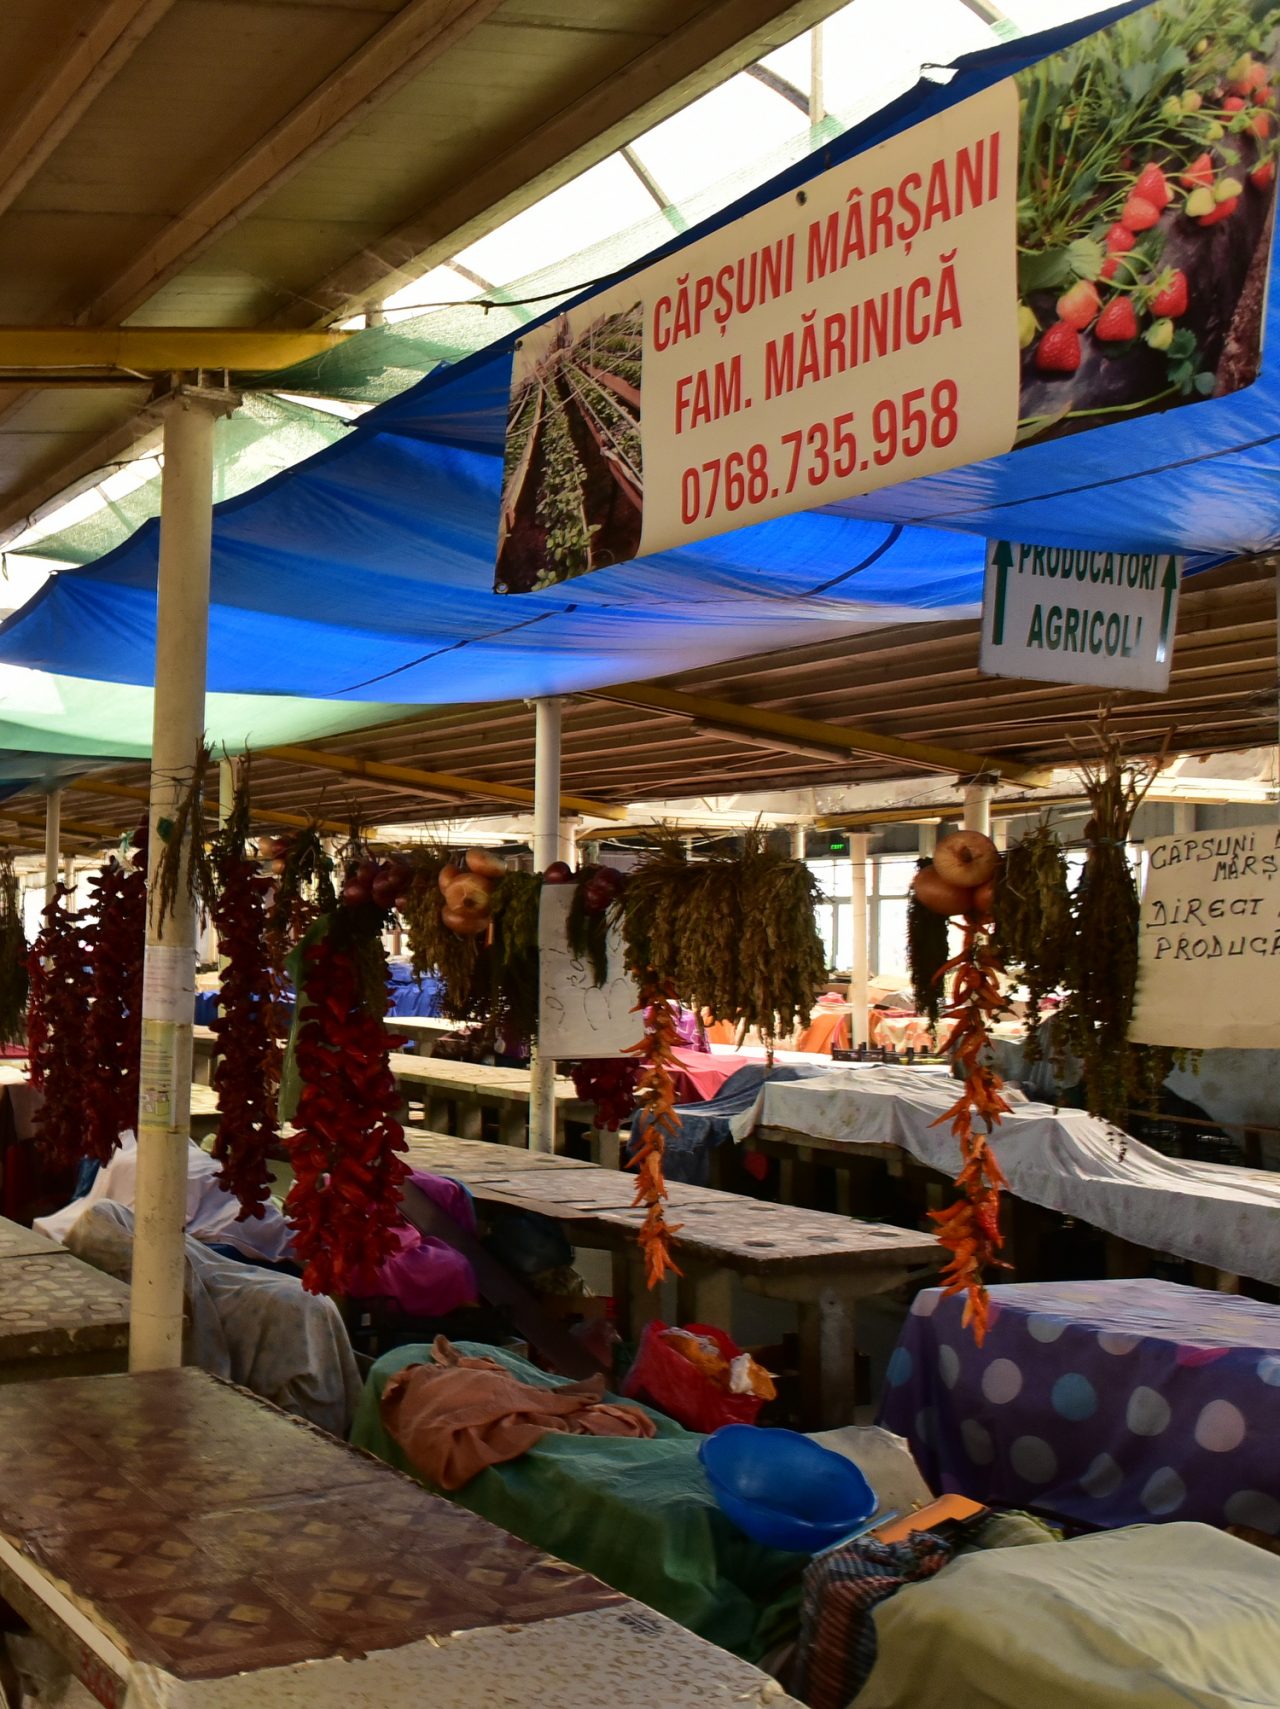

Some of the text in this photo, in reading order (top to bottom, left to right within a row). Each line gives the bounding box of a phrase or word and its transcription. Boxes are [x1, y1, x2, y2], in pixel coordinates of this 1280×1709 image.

[652, 131, 1000, 352] CĂPȘUNI MÂRȘANI
[674, 247, 963, 435] FAM. MĂRINICĂ
[680, 378, 958, 526] 0768.735.958
[1026, 604, 1143, 658] AGRICOLI
